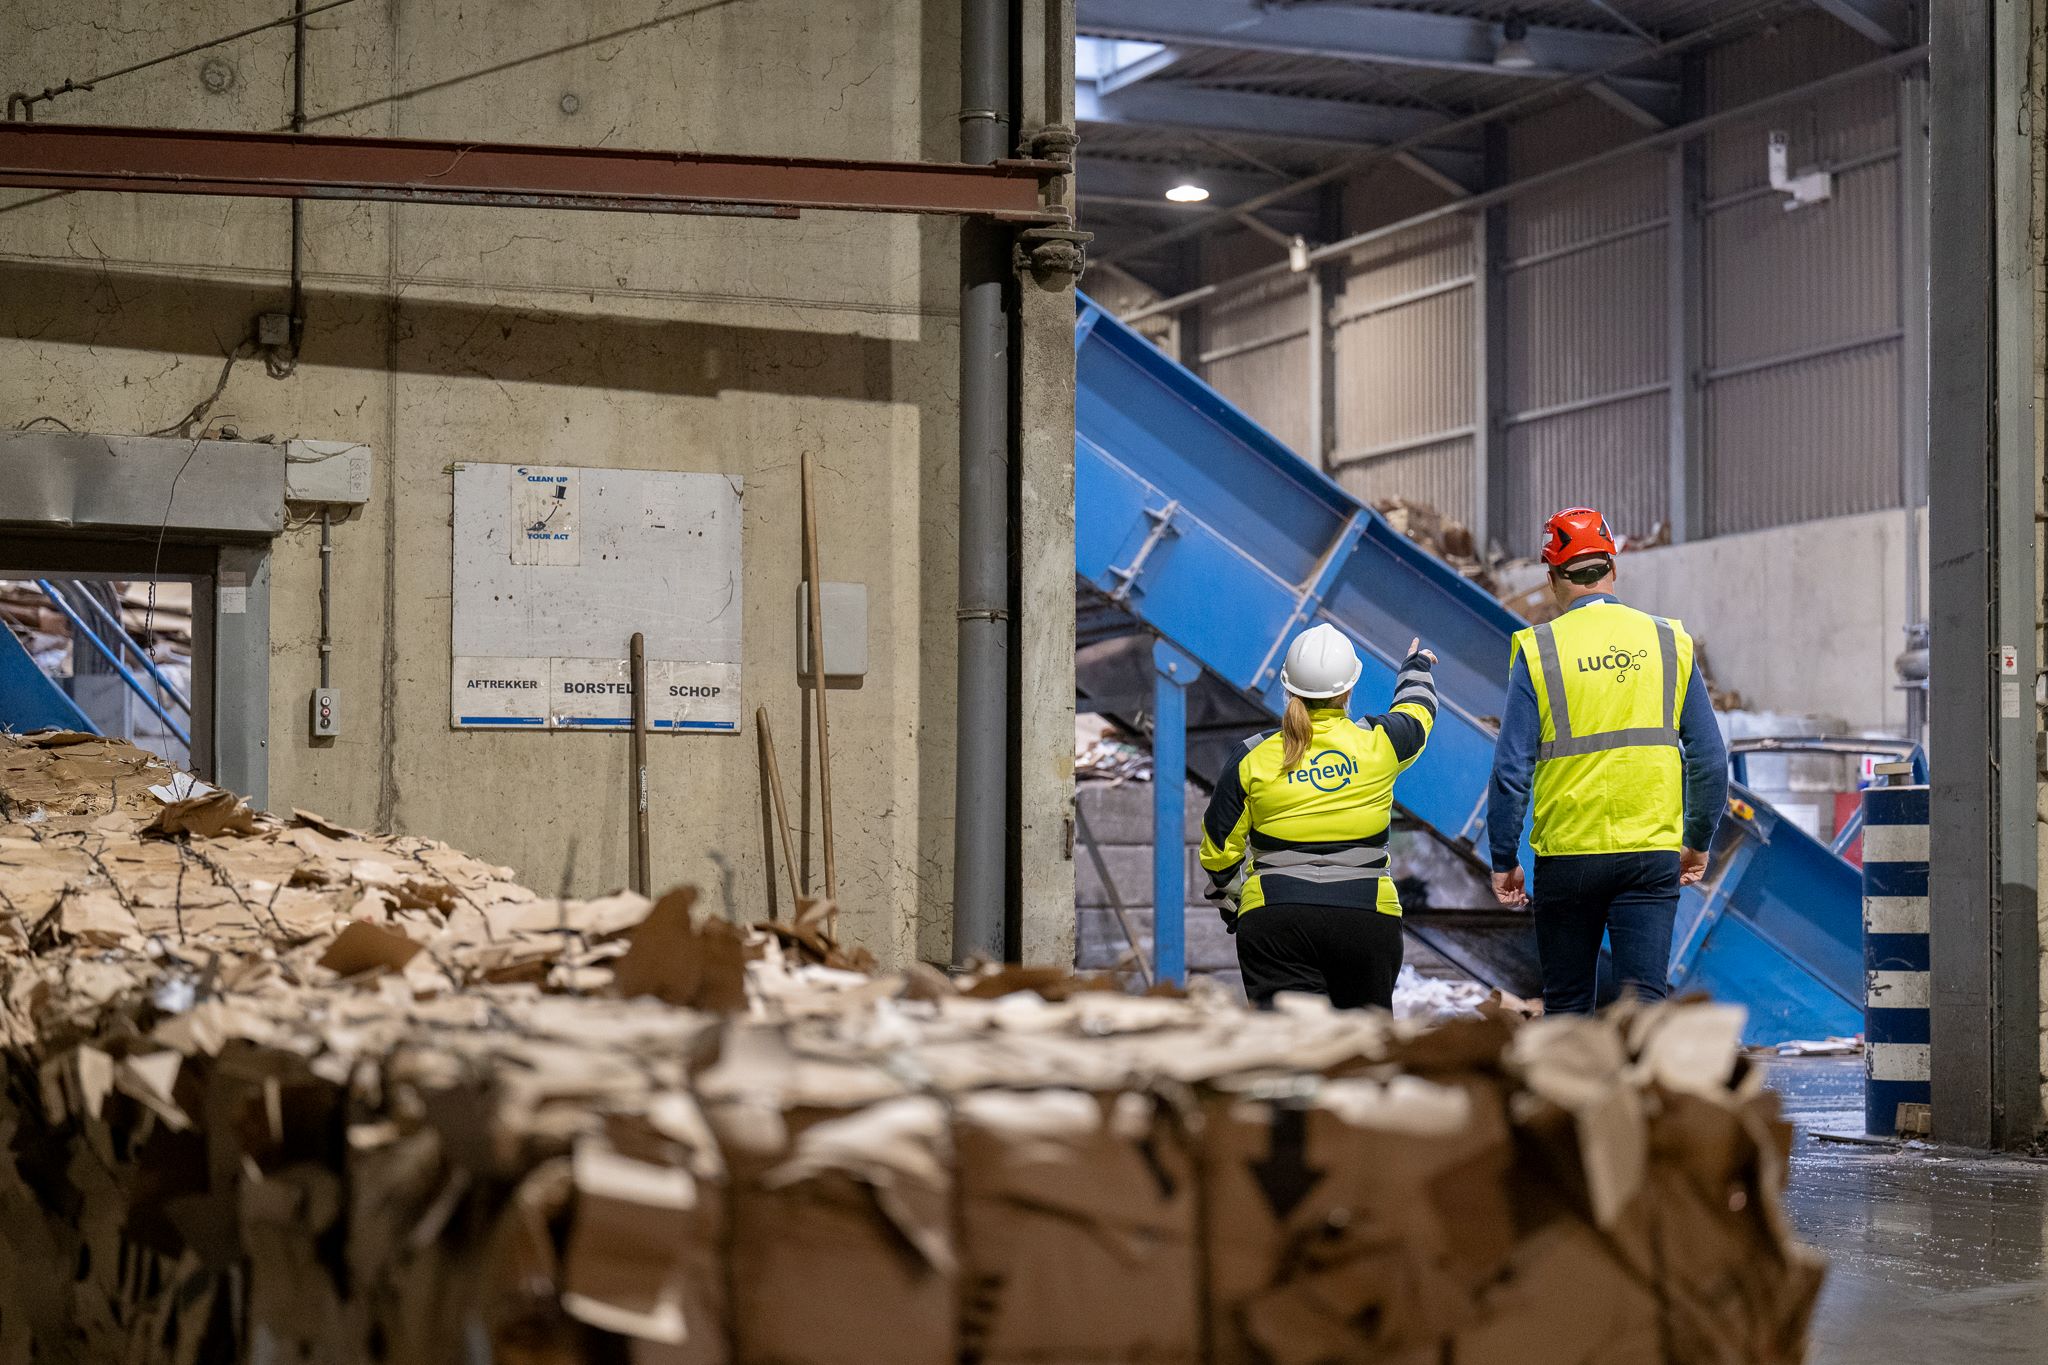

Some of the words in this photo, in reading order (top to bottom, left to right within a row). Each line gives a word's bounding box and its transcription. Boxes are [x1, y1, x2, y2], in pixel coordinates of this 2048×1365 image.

[527, 475, 553, 483] CLEAN
[1577, 653, 1631, 672] LUCO
[467, 680, 538, 688] AFTREKKER
[564, 682, 634, 694] BORSTEL
[669, 685, 721, 697] SCHOP
[1287, 758, 1359, 787] renewi
